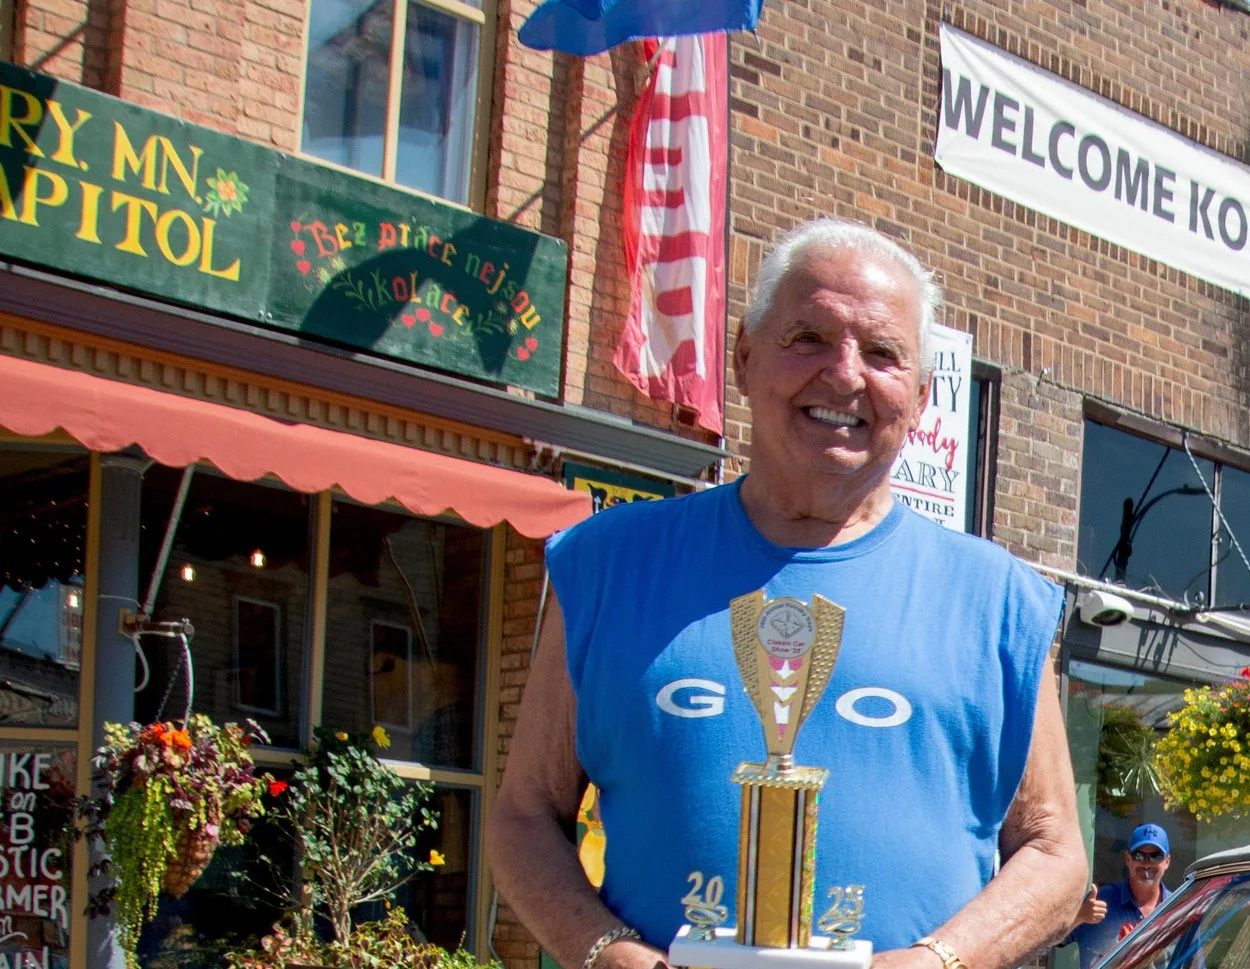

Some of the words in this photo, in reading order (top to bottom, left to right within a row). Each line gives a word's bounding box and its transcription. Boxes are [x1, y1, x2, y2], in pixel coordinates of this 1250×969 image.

[943, 68, 1176, 224] WELCOME
[303, 219, 367, 258] Bez
[894, 494, 955, 518] NTIRE
[10, 791, 36, 812] on
[680, 871, 725, 909] 20
[819, 884, 867, 923] 25
